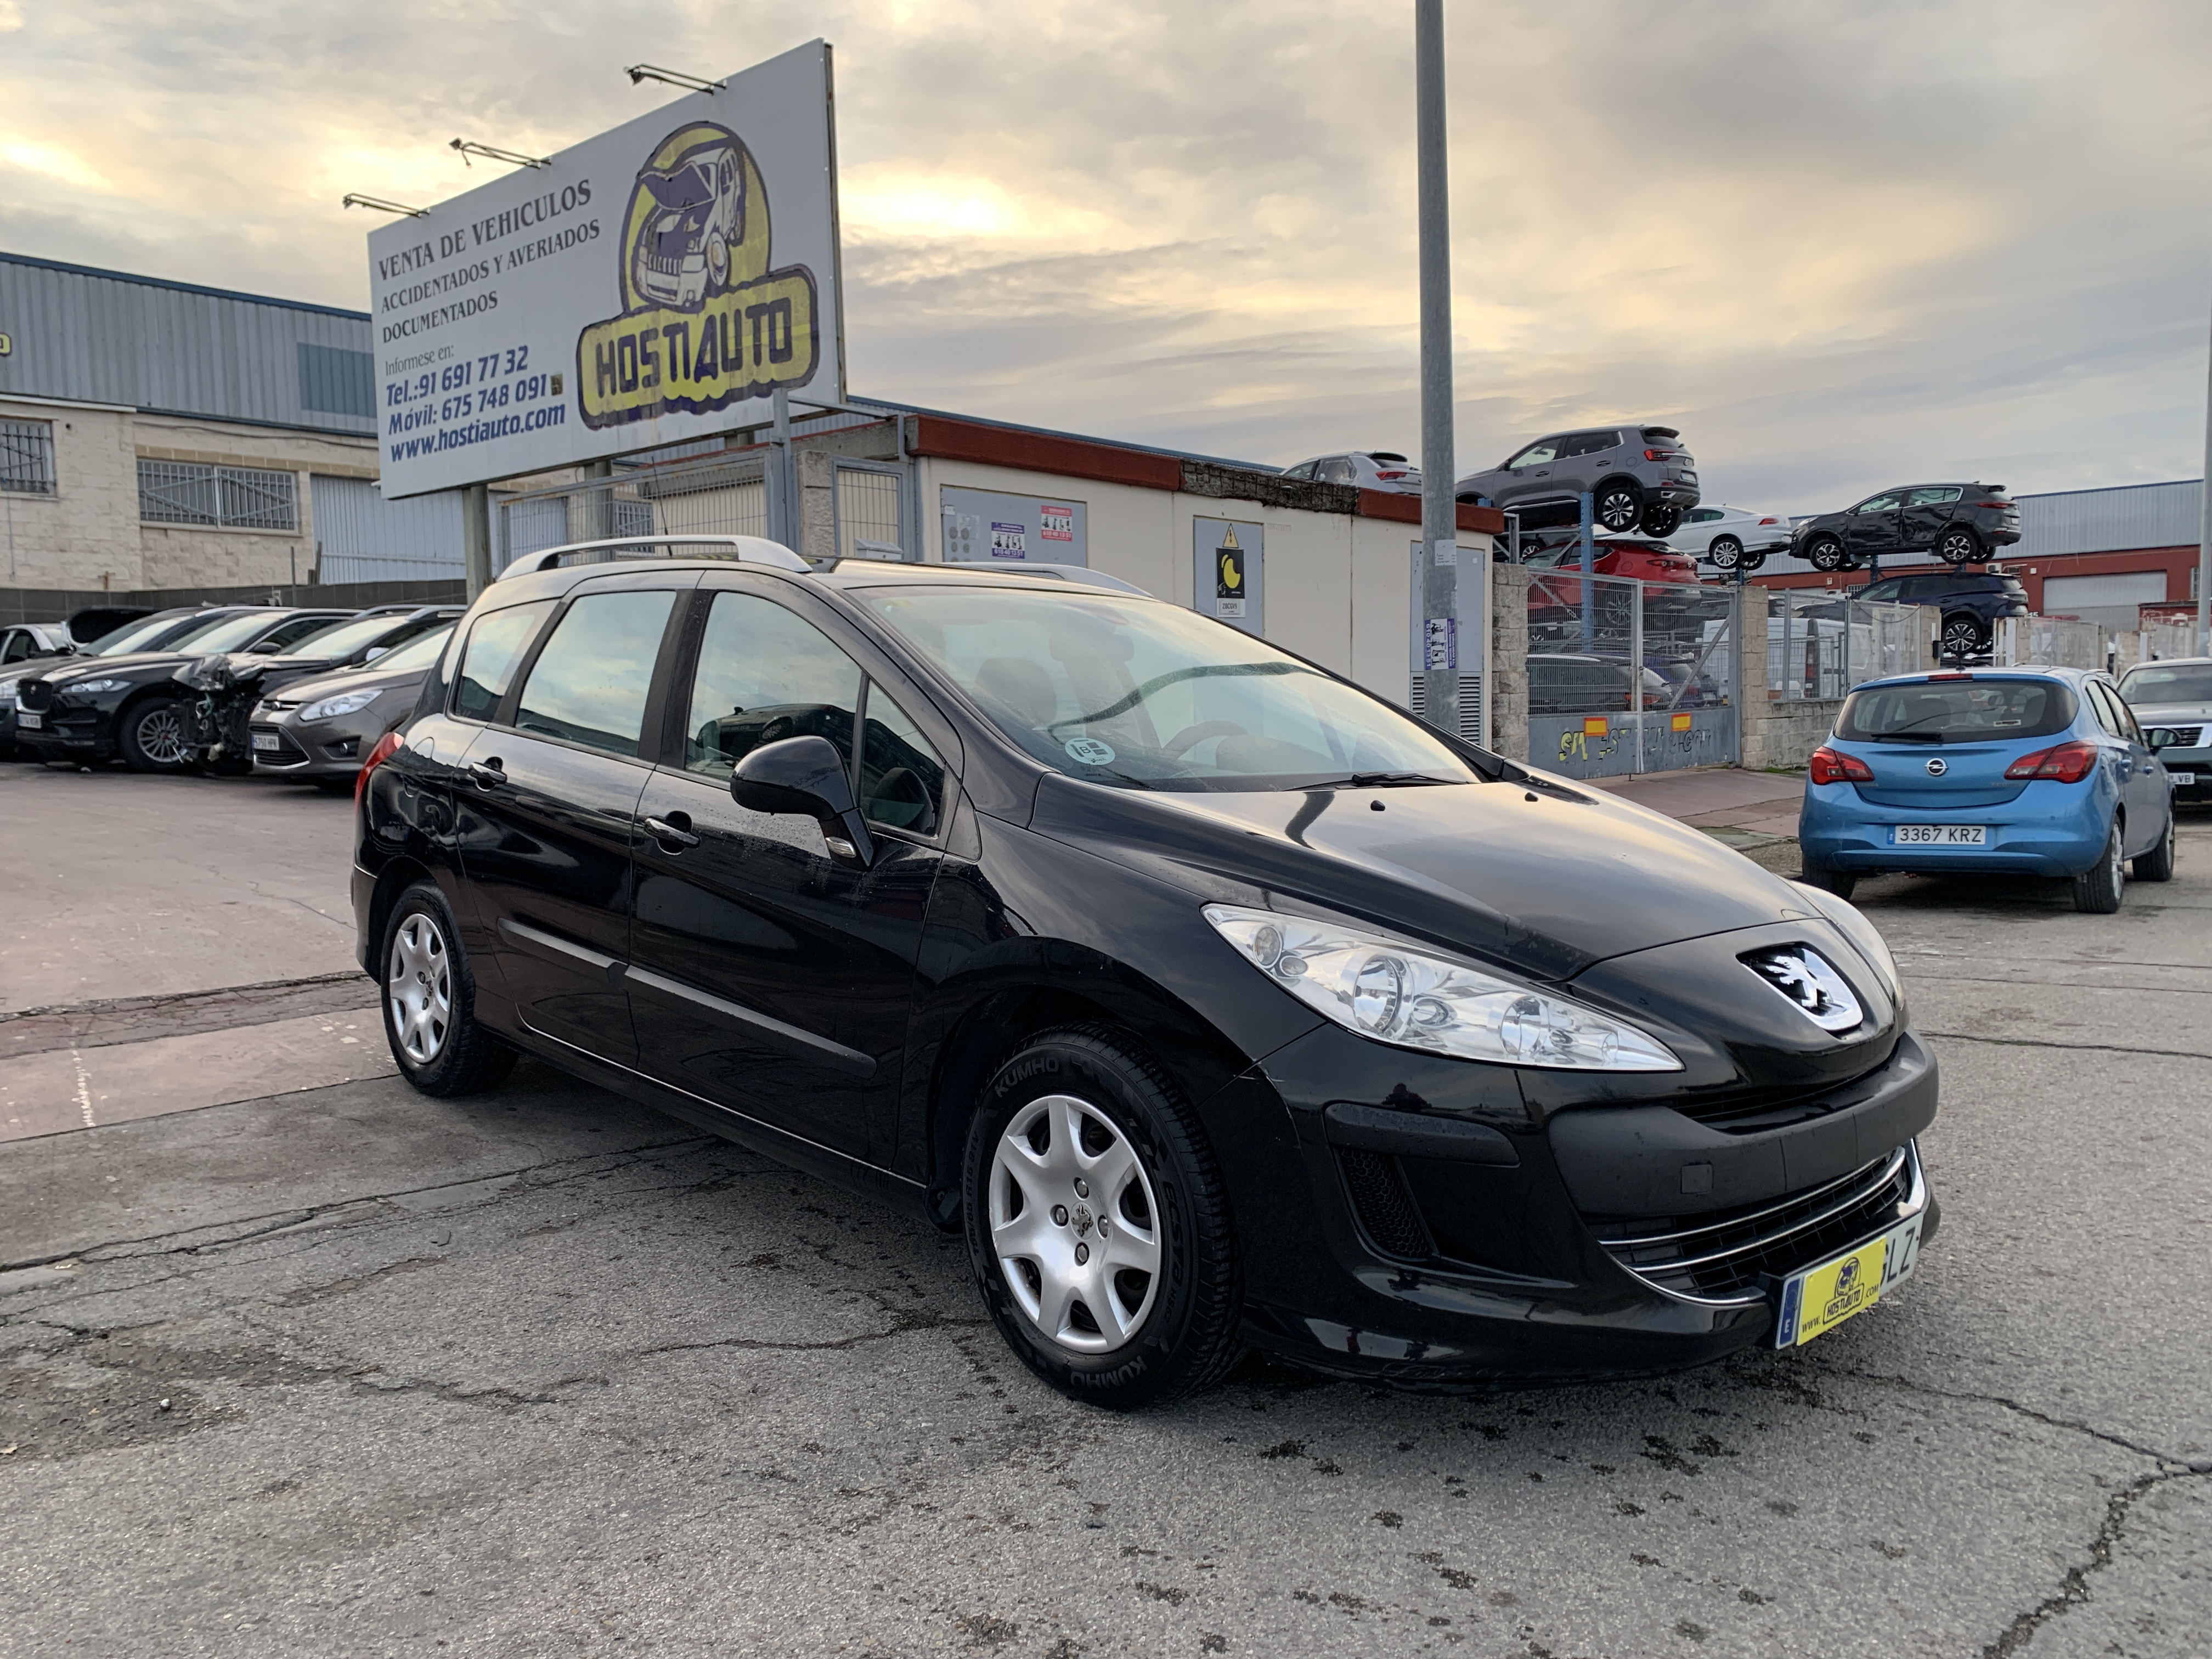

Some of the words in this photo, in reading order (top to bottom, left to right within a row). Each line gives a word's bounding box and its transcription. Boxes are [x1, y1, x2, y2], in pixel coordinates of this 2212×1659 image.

[379, 242, 433, 281] VENTA
[441, 229, 466, 260] DE
[472, 179, 592, 246] VEHICULOS
[381, 261, 489, 314] ACCIDENTADOS
[493, 256, 504, 275] Y
[506, 219, 600, 271] AVERIADOS
[383, 291, 498, 343] DOCUMENTADOS
[385, 349, 436, 376] Informese
[438, 344, 454, 361] en:
[442, 360, 472, 392] 691
[478, 353, 500, 382] 77
[504, 345, 528, 375] 32
[596, 298, 793, 398] HOSTIAUTO
[388, 406, 438, 436] Móvil:
[442, 393, 472, 422] 675
[478, 385, 509, 413] 748
[515, 373, 547, 403] 091
[390, 403, 566, 462] www.hostiauto.com
[1900, 828, 1942, 842] 3367
[1949, 828, 1982, 842] KRZ
[995, 1056, 1059, 1098] KUMHO
[1784, 1318, 1791, 1334] E
[1826, 1292, 1861, 1316] HOSTIAUTO
[1070, 1356, 1148, 1390] KUMHO
